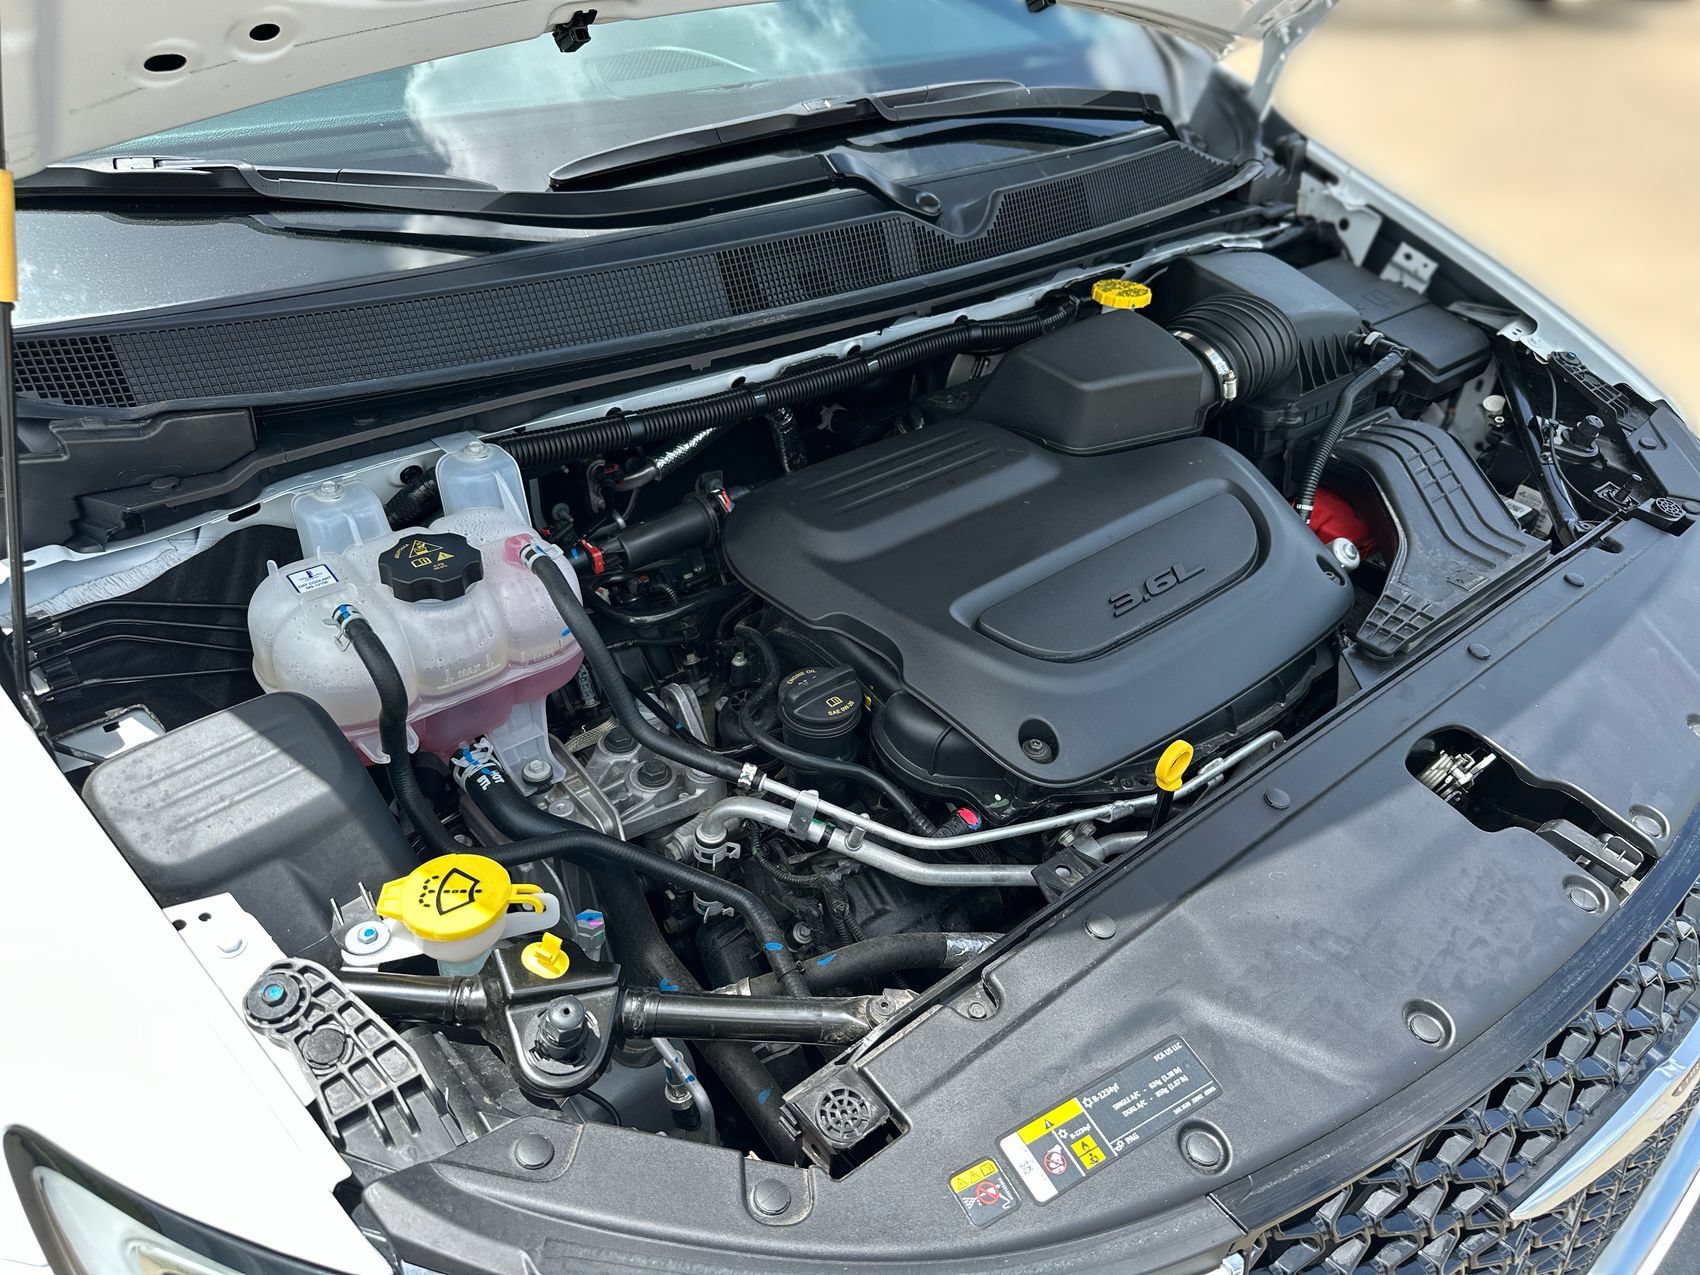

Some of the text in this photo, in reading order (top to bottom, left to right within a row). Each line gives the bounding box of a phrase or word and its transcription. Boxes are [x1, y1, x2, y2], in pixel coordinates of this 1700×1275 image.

[1109, 562, 1205, 618] 3.6L
[787, 671, 805, 685] ENGINE
[1125, 1132, 1139, 1144] PAG
